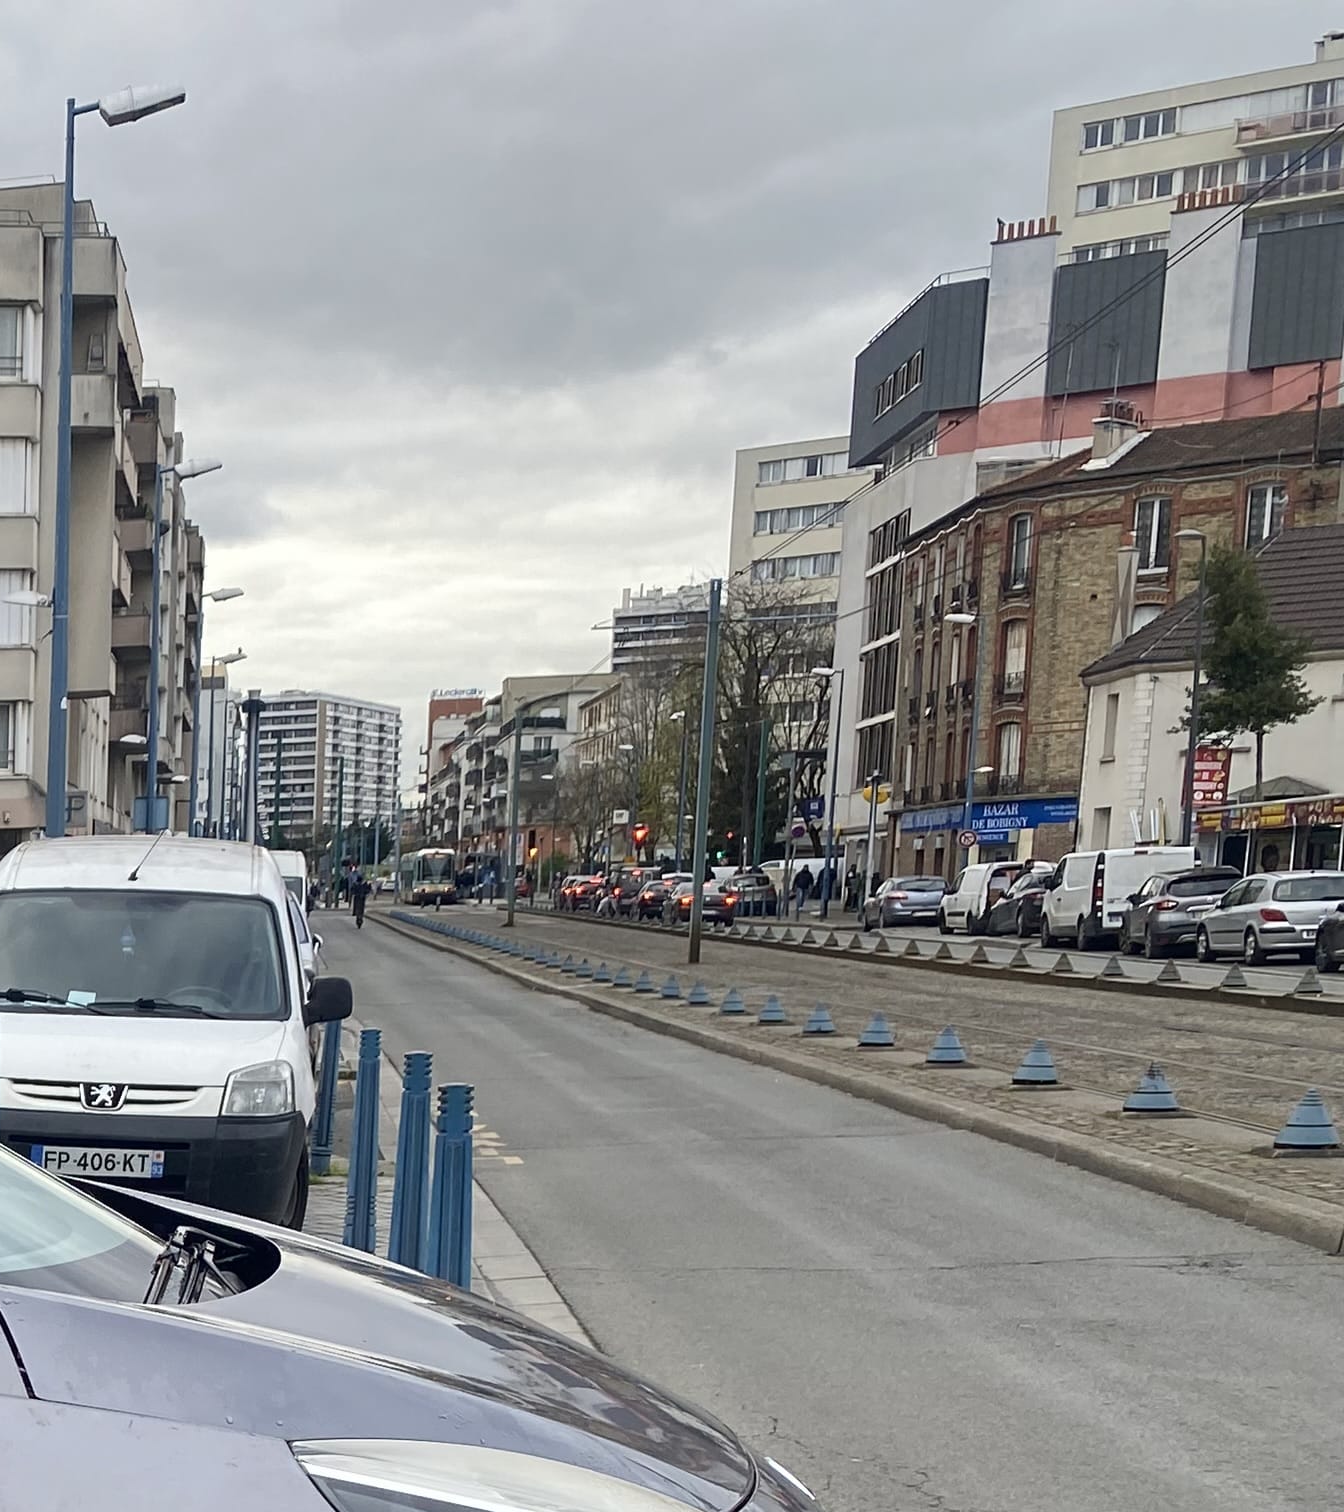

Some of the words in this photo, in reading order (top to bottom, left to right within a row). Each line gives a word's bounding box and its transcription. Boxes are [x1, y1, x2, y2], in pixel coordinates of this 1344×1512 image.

[983, 803, 1019, 817] BAZAR
[972, 820, 986, 830] DE
[986, 817, 1029, 829] BOBIGNY
[43, 1150, 150, 1173] FP-406-KT
